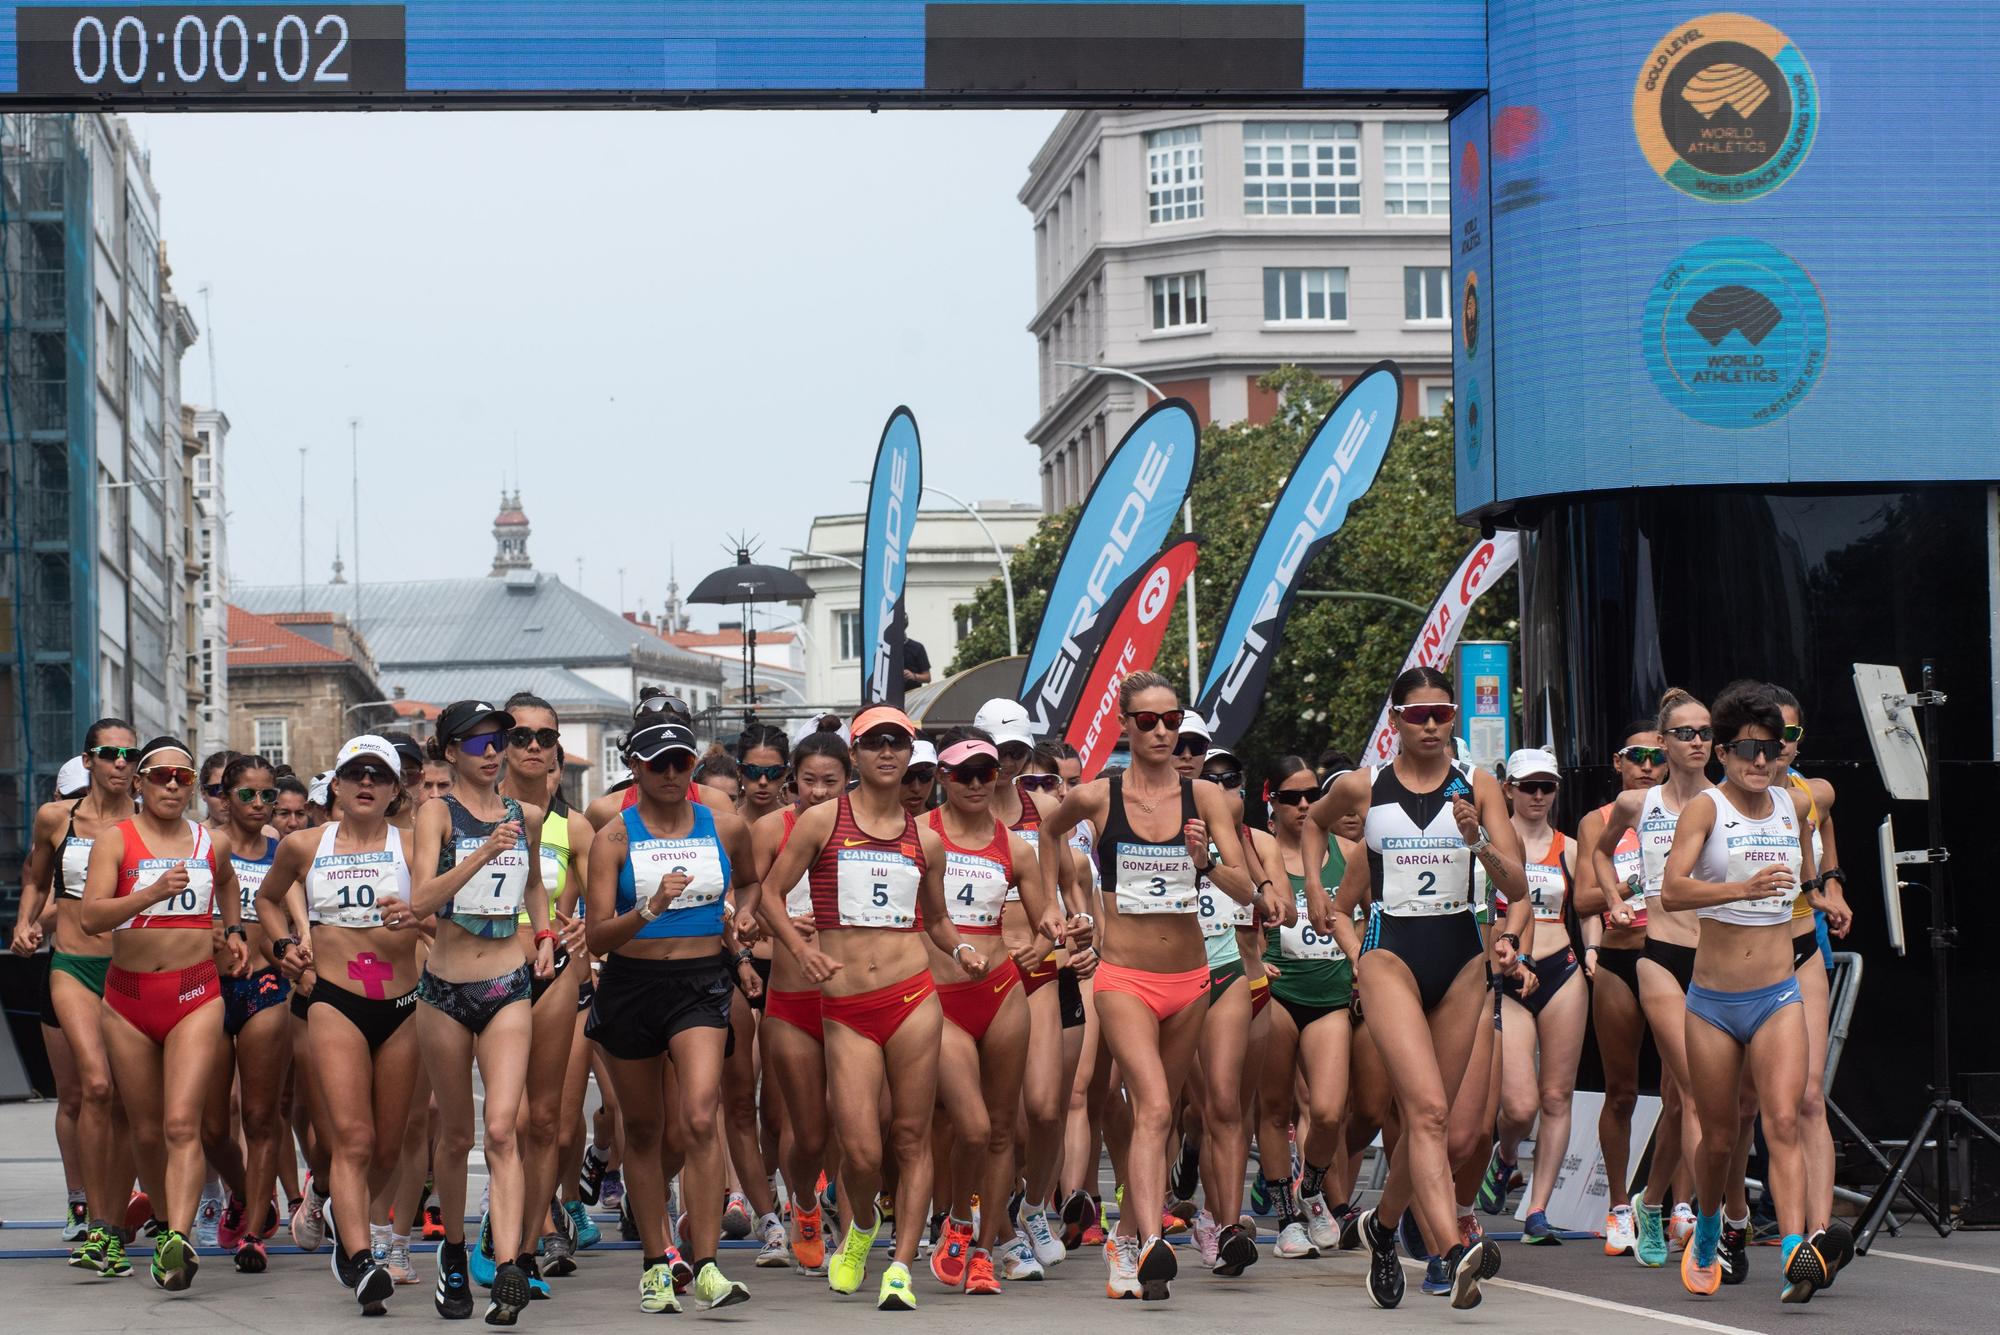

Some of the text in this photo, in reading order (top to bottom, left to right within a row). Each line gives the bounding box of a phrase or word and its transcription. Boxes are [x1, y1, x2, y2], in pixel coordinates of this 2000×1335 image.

[72, 14, 349, 84] 00:00:02
[1645, 28, 1705, 91] GOLD LEVEL
[1696, 73, 1811, 194] WORLD RACE WALKING TOUR
[1701, 127, 1754, 140] WORLD
[1687, 142, 1767, 153] ATHLETICS
[1663, 263, 1687, 290] CITY
[1706, 355, 1765, 368] WORLD
[1693, 369, 1779, 383] ATHLETICS
[1753, 349, 1821, 419] HERITAGE SITE
[1483, 686, 1493, 694] 17
[1079, 636, 1137, 769] DEPORTE
[1482, 696, 1493, 704] 23
[634, 838, 714, 850] CANTONES23
[1732, 835, 1797, 846] CANTONES23
[320, 852, 393, 866] CANTONES23
[651, 850, 697, 862] ORTUÑO
[1396, 853, 1454, 865] GARCÍA K.
[1744, 849, 1790, 862] PÉREZ M.
[871, 867, 889, 877] LIU
[1122, 860, 1191, 872] GONZÁLEZ R.
[491, 873, 507, 898] 7
[1149, 876, 1167, 897] 3
[1417, 870, 1437, 896] 2
[167, 888, 196, 911] 70
[337, 884, 375, 909] 10
[871, 883, 889, 907] 5
[956, 883, 975, 906] 4
[1200, 895, 1215, 918] 8
[178, 984, 206, 1004] PERÚ
[395, 990, 418, 1008] NIKE
